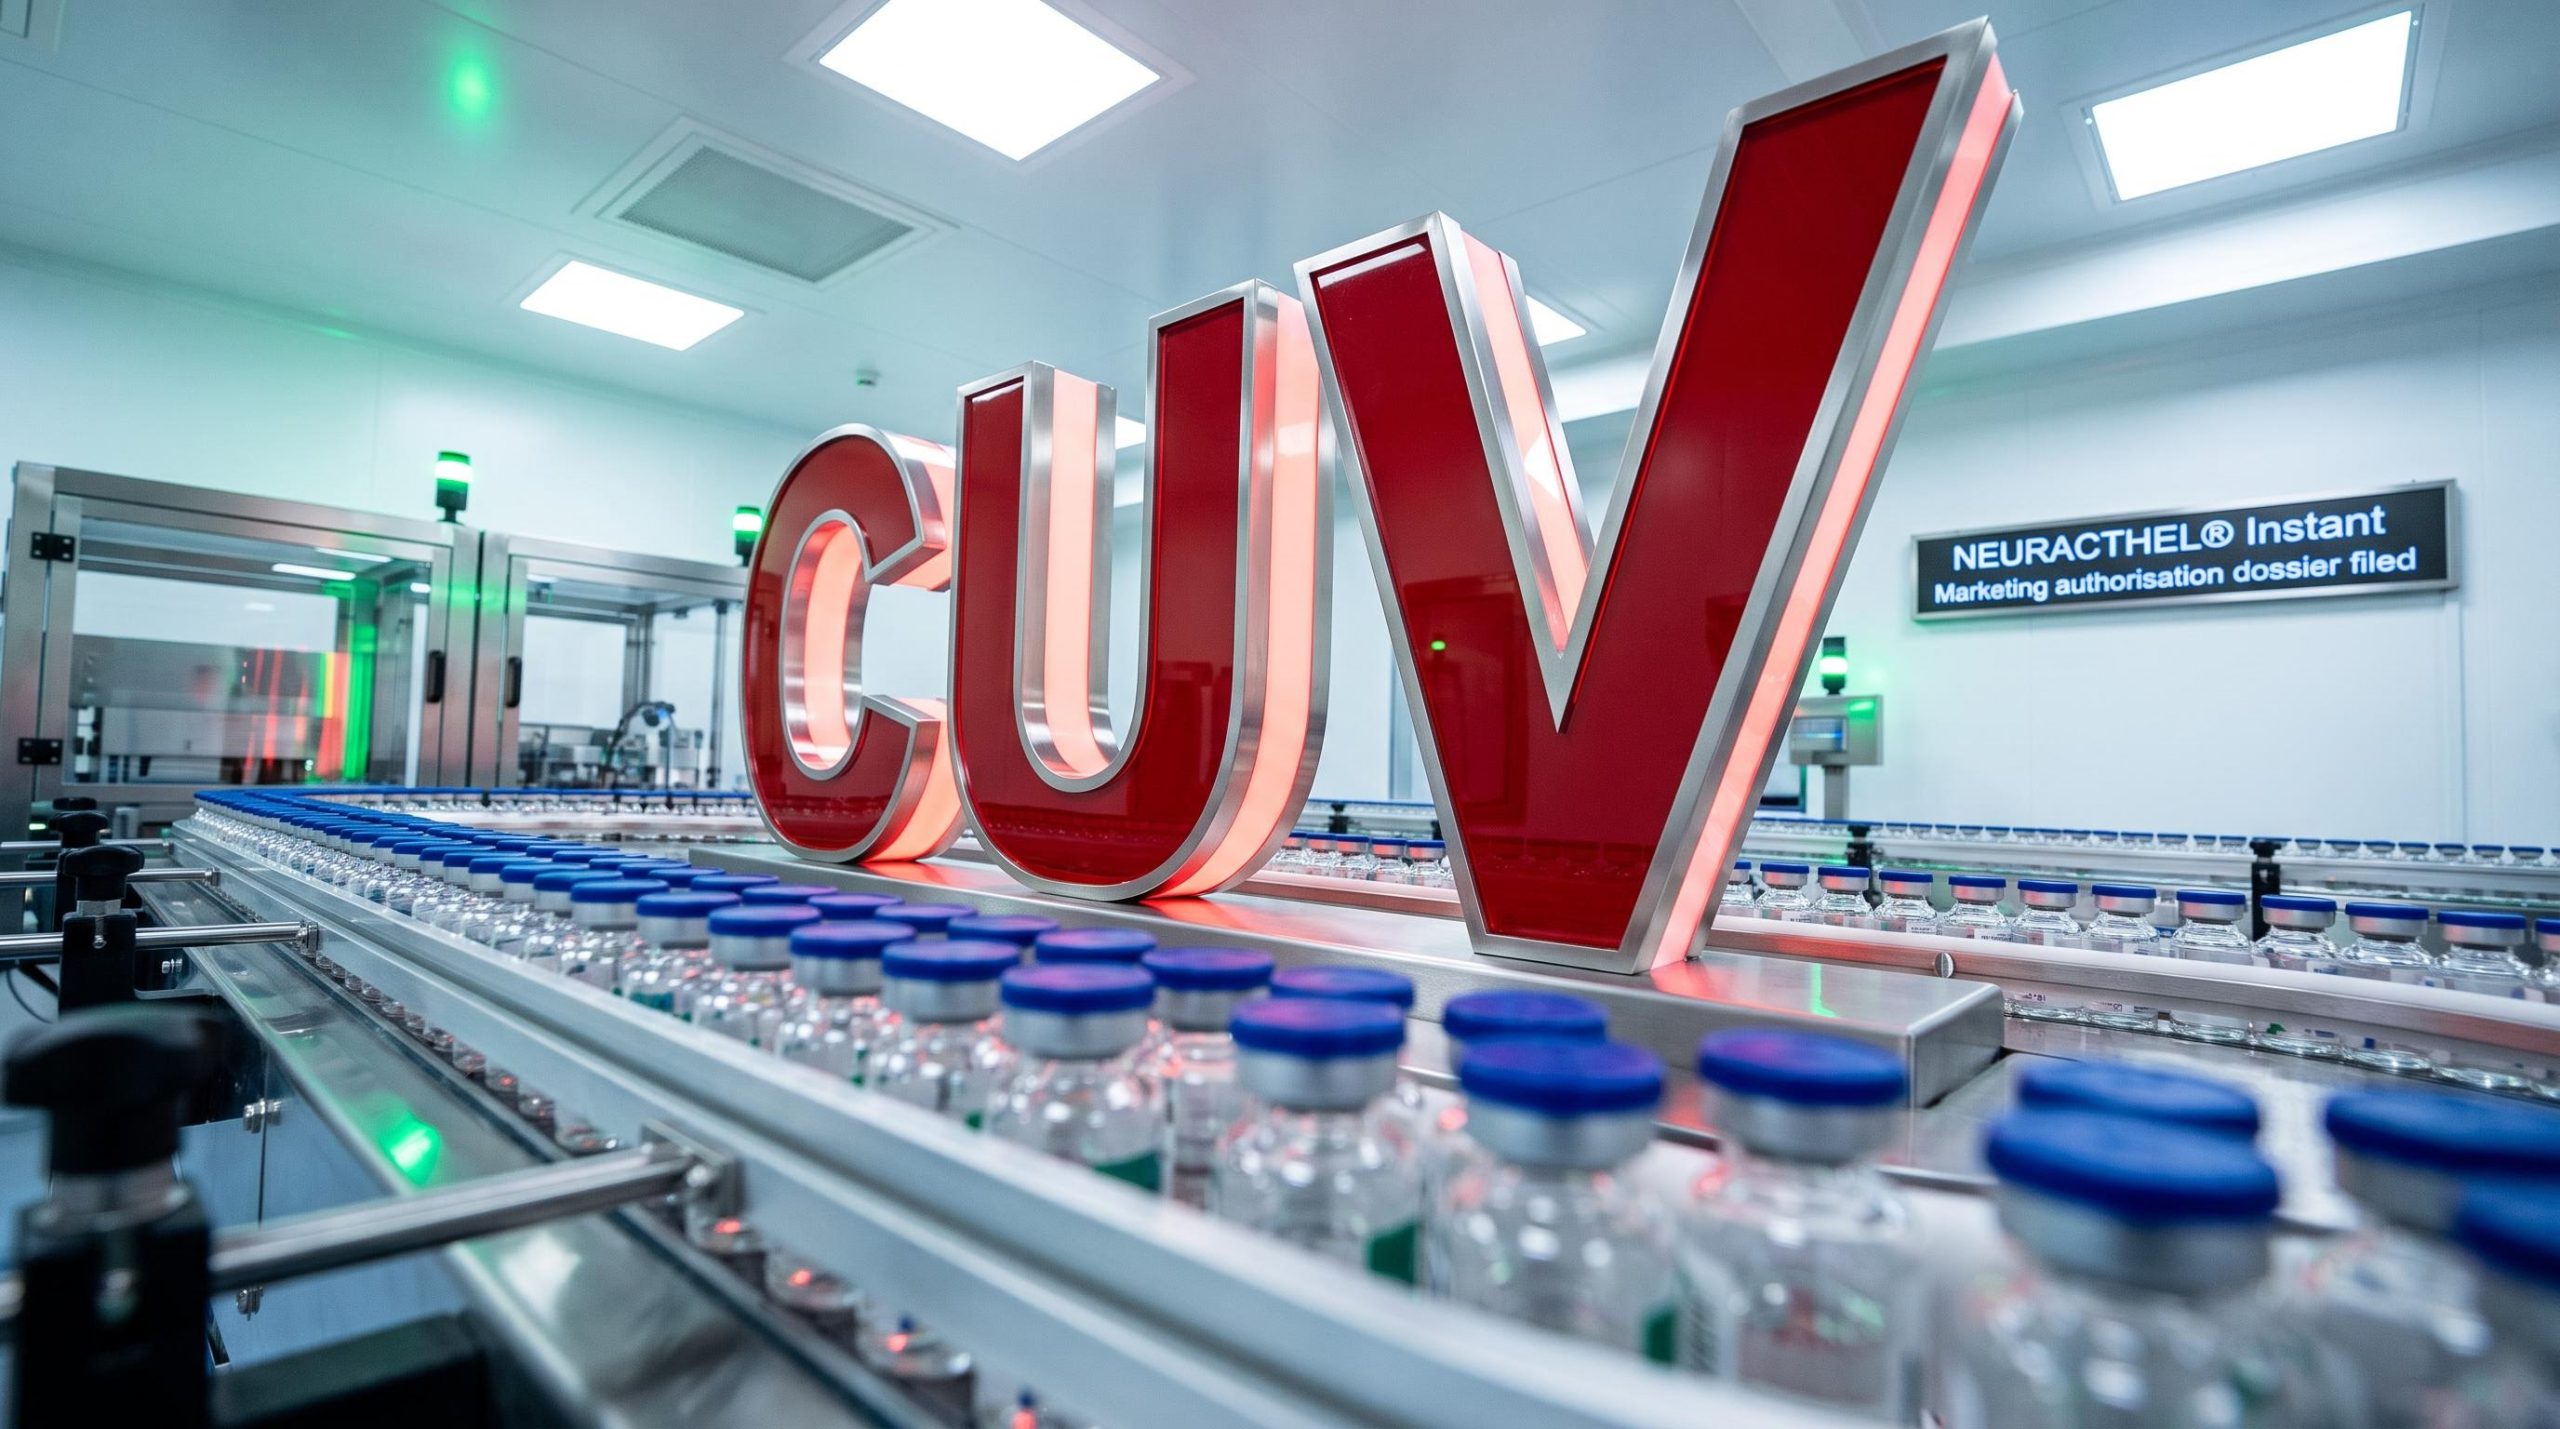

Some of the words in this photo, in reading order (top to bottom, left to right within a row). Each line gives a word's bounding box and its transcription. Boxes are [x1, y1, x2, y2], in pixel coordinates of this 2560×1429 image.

[741, 16, 2022, 975] CUV
[1953, 519, 2235, 571] NEURACTHEL®
[2246, 505, 2387, 546] Instant
[1934, 577, 2049, 604] Marketing
[2054, 563, 2225, 596] authorisation
[2232, 554, 2343, 583] dossier
[2348, 546, 2416, 575] filed
